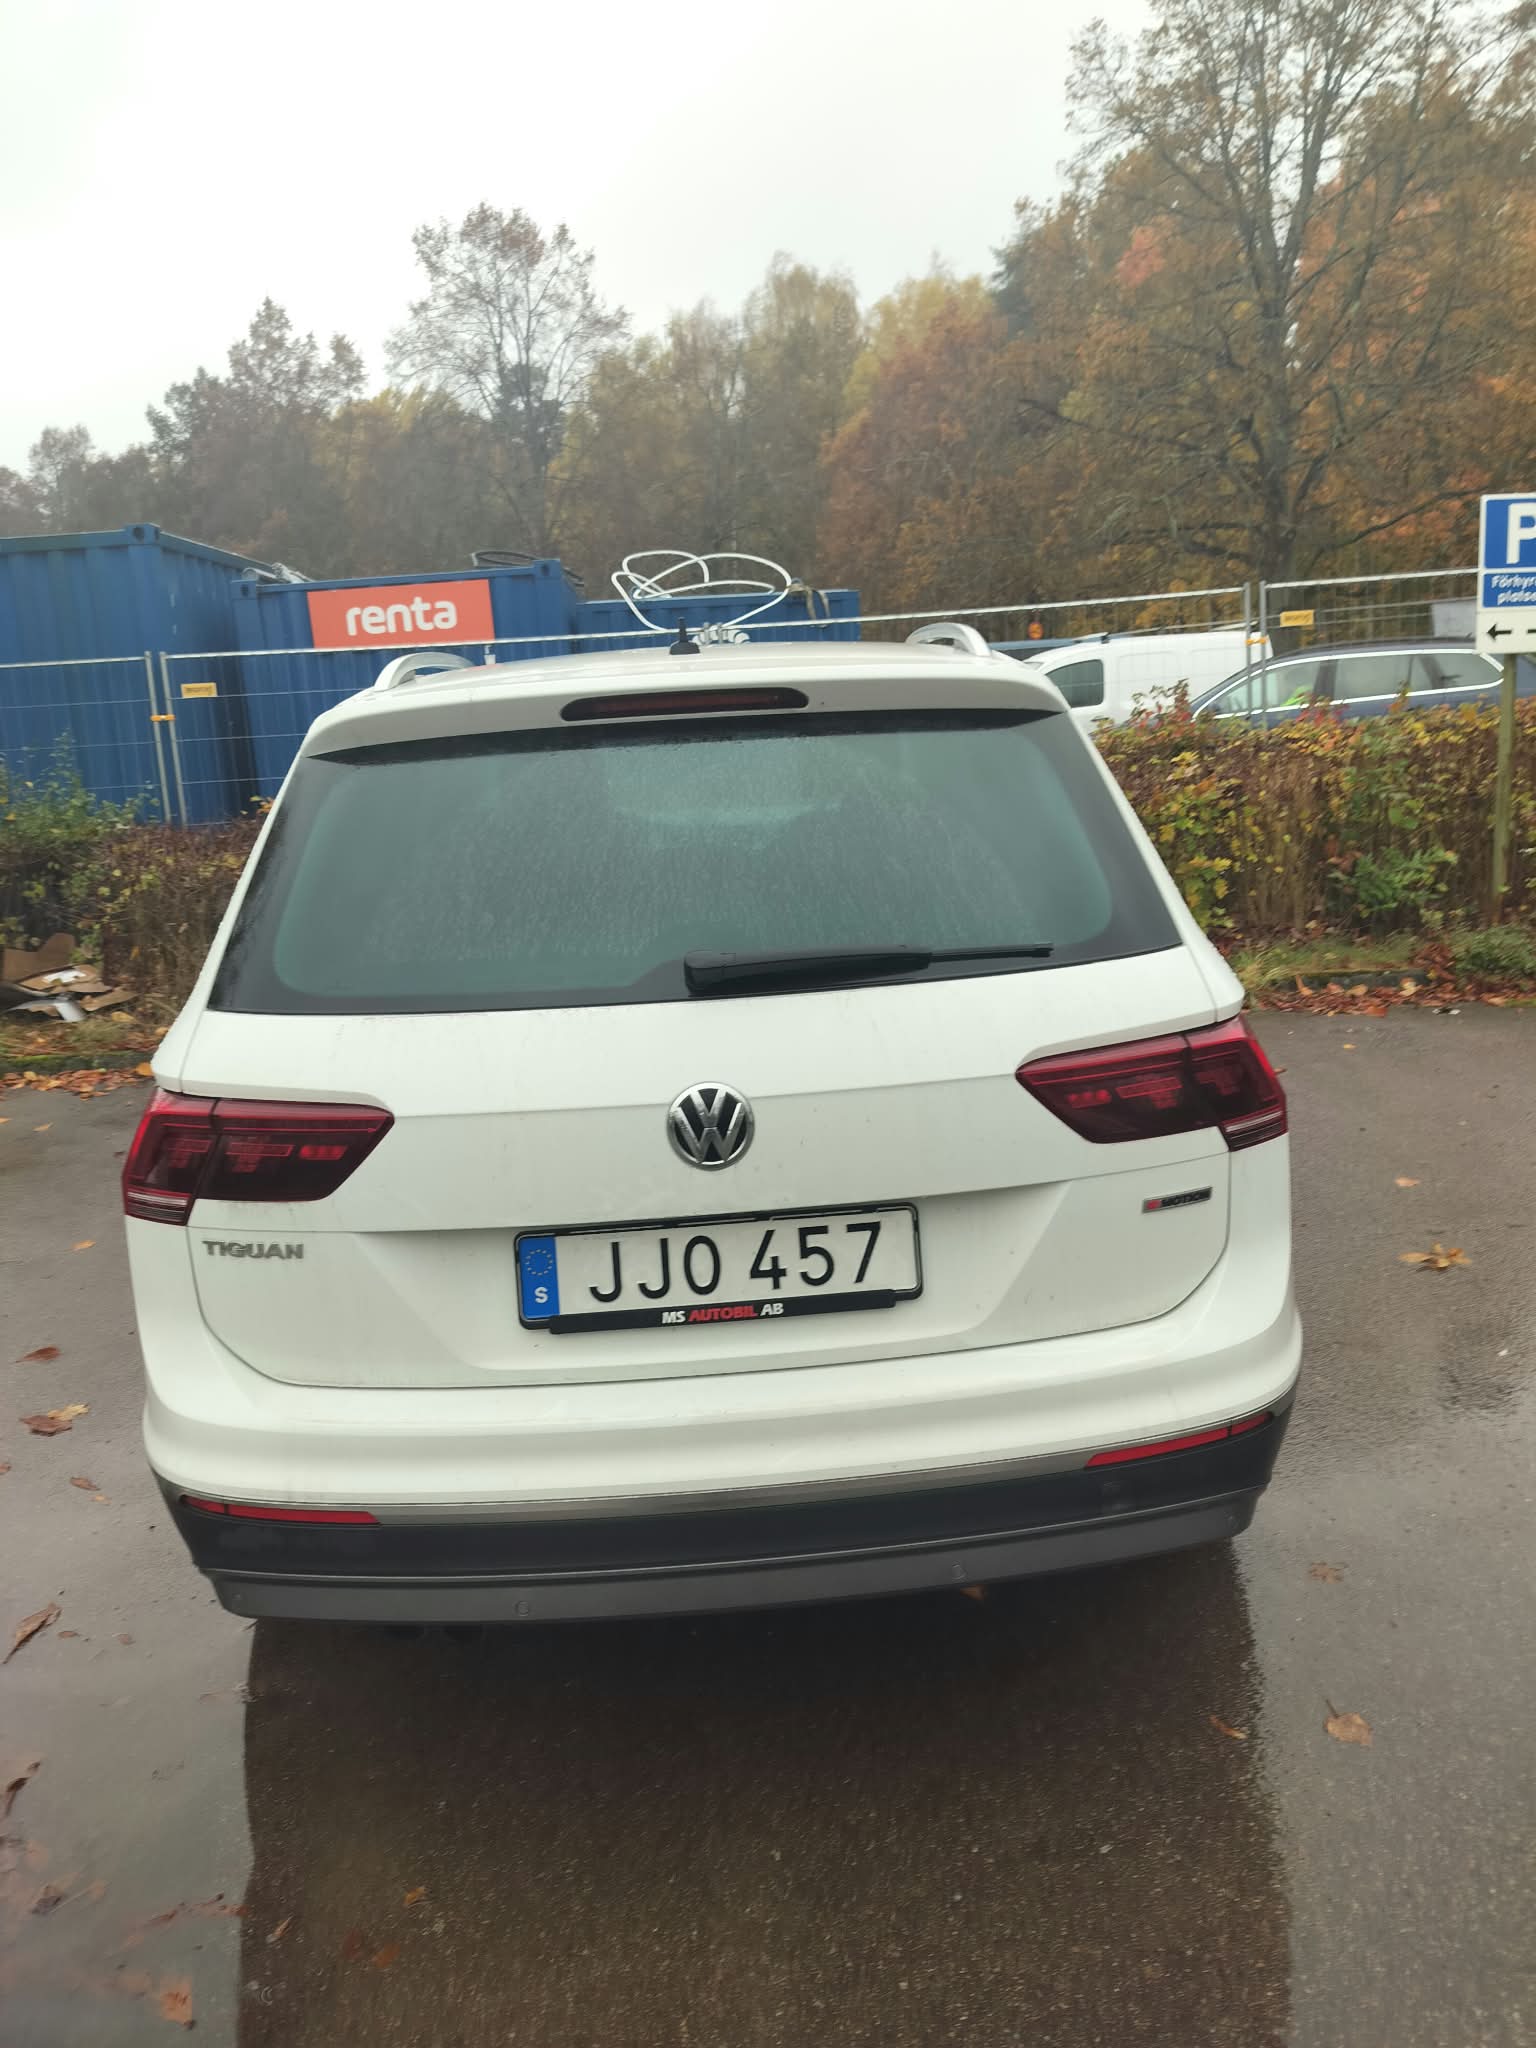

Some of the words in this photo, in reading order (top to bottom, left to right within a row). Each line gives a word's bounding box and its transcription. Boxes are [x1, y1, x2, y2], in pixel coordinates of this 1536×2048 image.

[1506, 502, 1536, 565] P
[1491, 574, 1536, 590] Förhyr
[345, 596, 459, 637] renta
[201, 1240, 305, 1260] TIGUAN
[589, 1234, 721, 1303] JJO
[748, 1220, 883, 1291] 457
[534, 1286, 549, 1304] S
[661, 1310, 686, 1324] MS
[688, 1305, 758, 1322] AUTOBIL
[760, 1302, 784, 1317] AB
